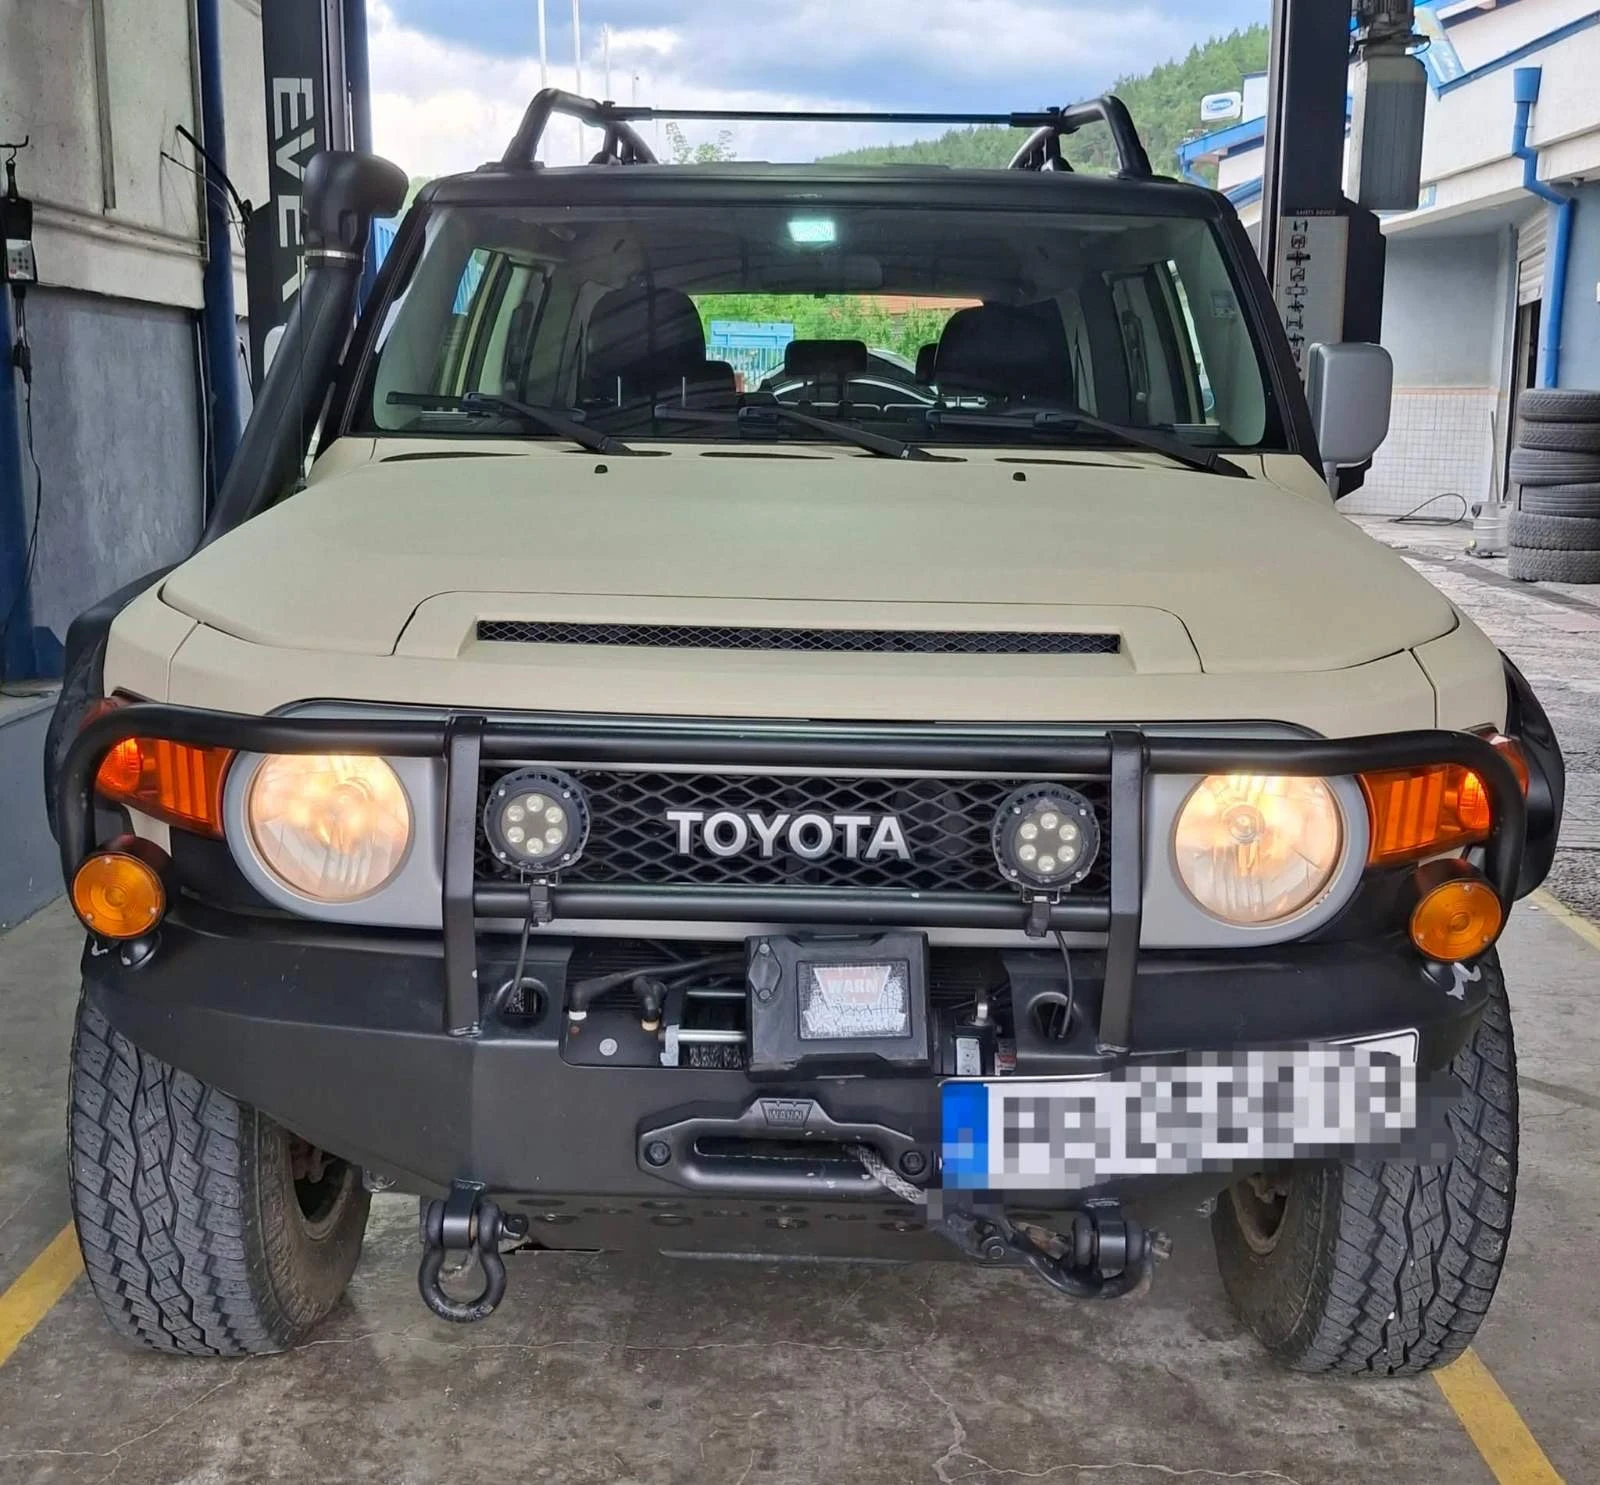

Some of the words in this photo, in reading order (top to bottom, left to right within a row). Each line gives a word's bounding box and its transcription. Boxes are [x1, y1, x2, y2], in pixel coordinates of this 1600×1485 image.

[666, 811, 911, 859] TOYOTA
[827, 979, 879, 993] WARN
[768, 1109, 804, 1121] WARN
